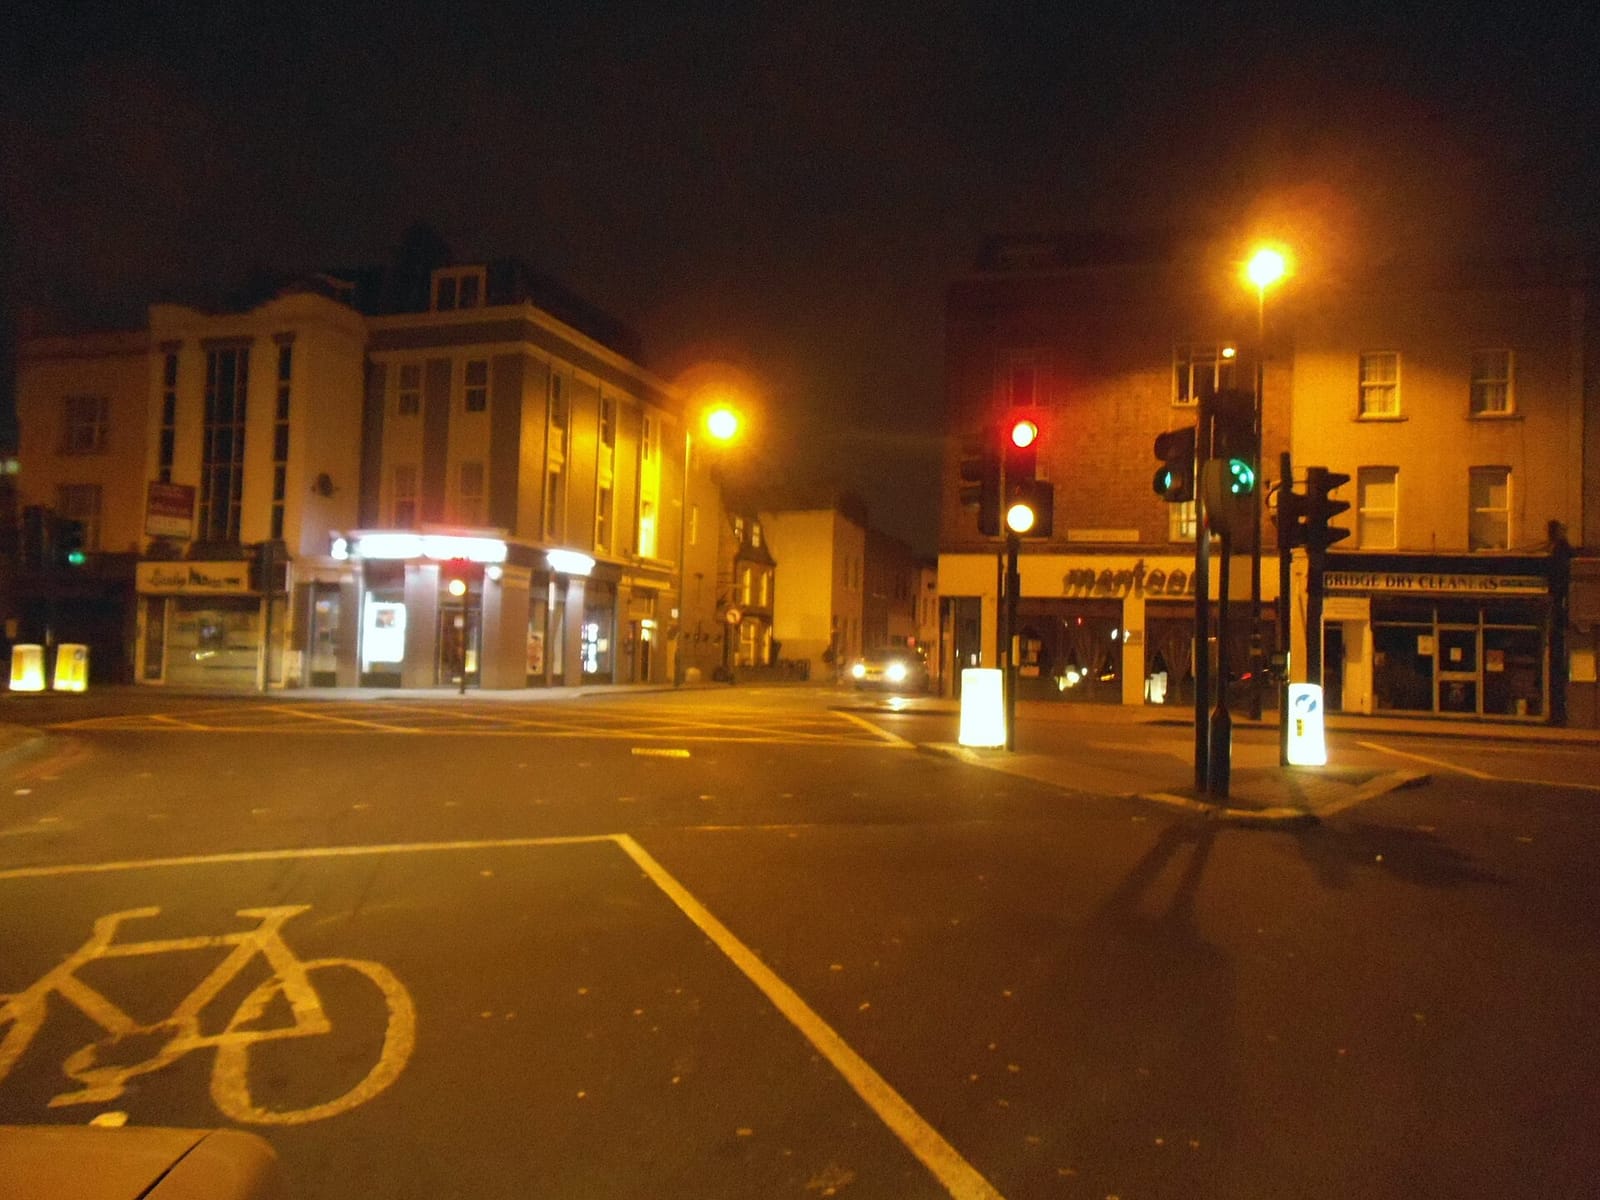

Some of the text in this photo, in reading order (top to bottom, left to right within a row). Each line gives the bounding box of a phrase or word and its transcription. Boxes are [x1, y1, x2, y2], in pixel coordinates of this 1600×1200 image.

[1324, 573, 1380, 588] BRIDGE
[1385, 574, 1414, 588] DRY
[1418, 575, 1498, 590] CLEANERS
